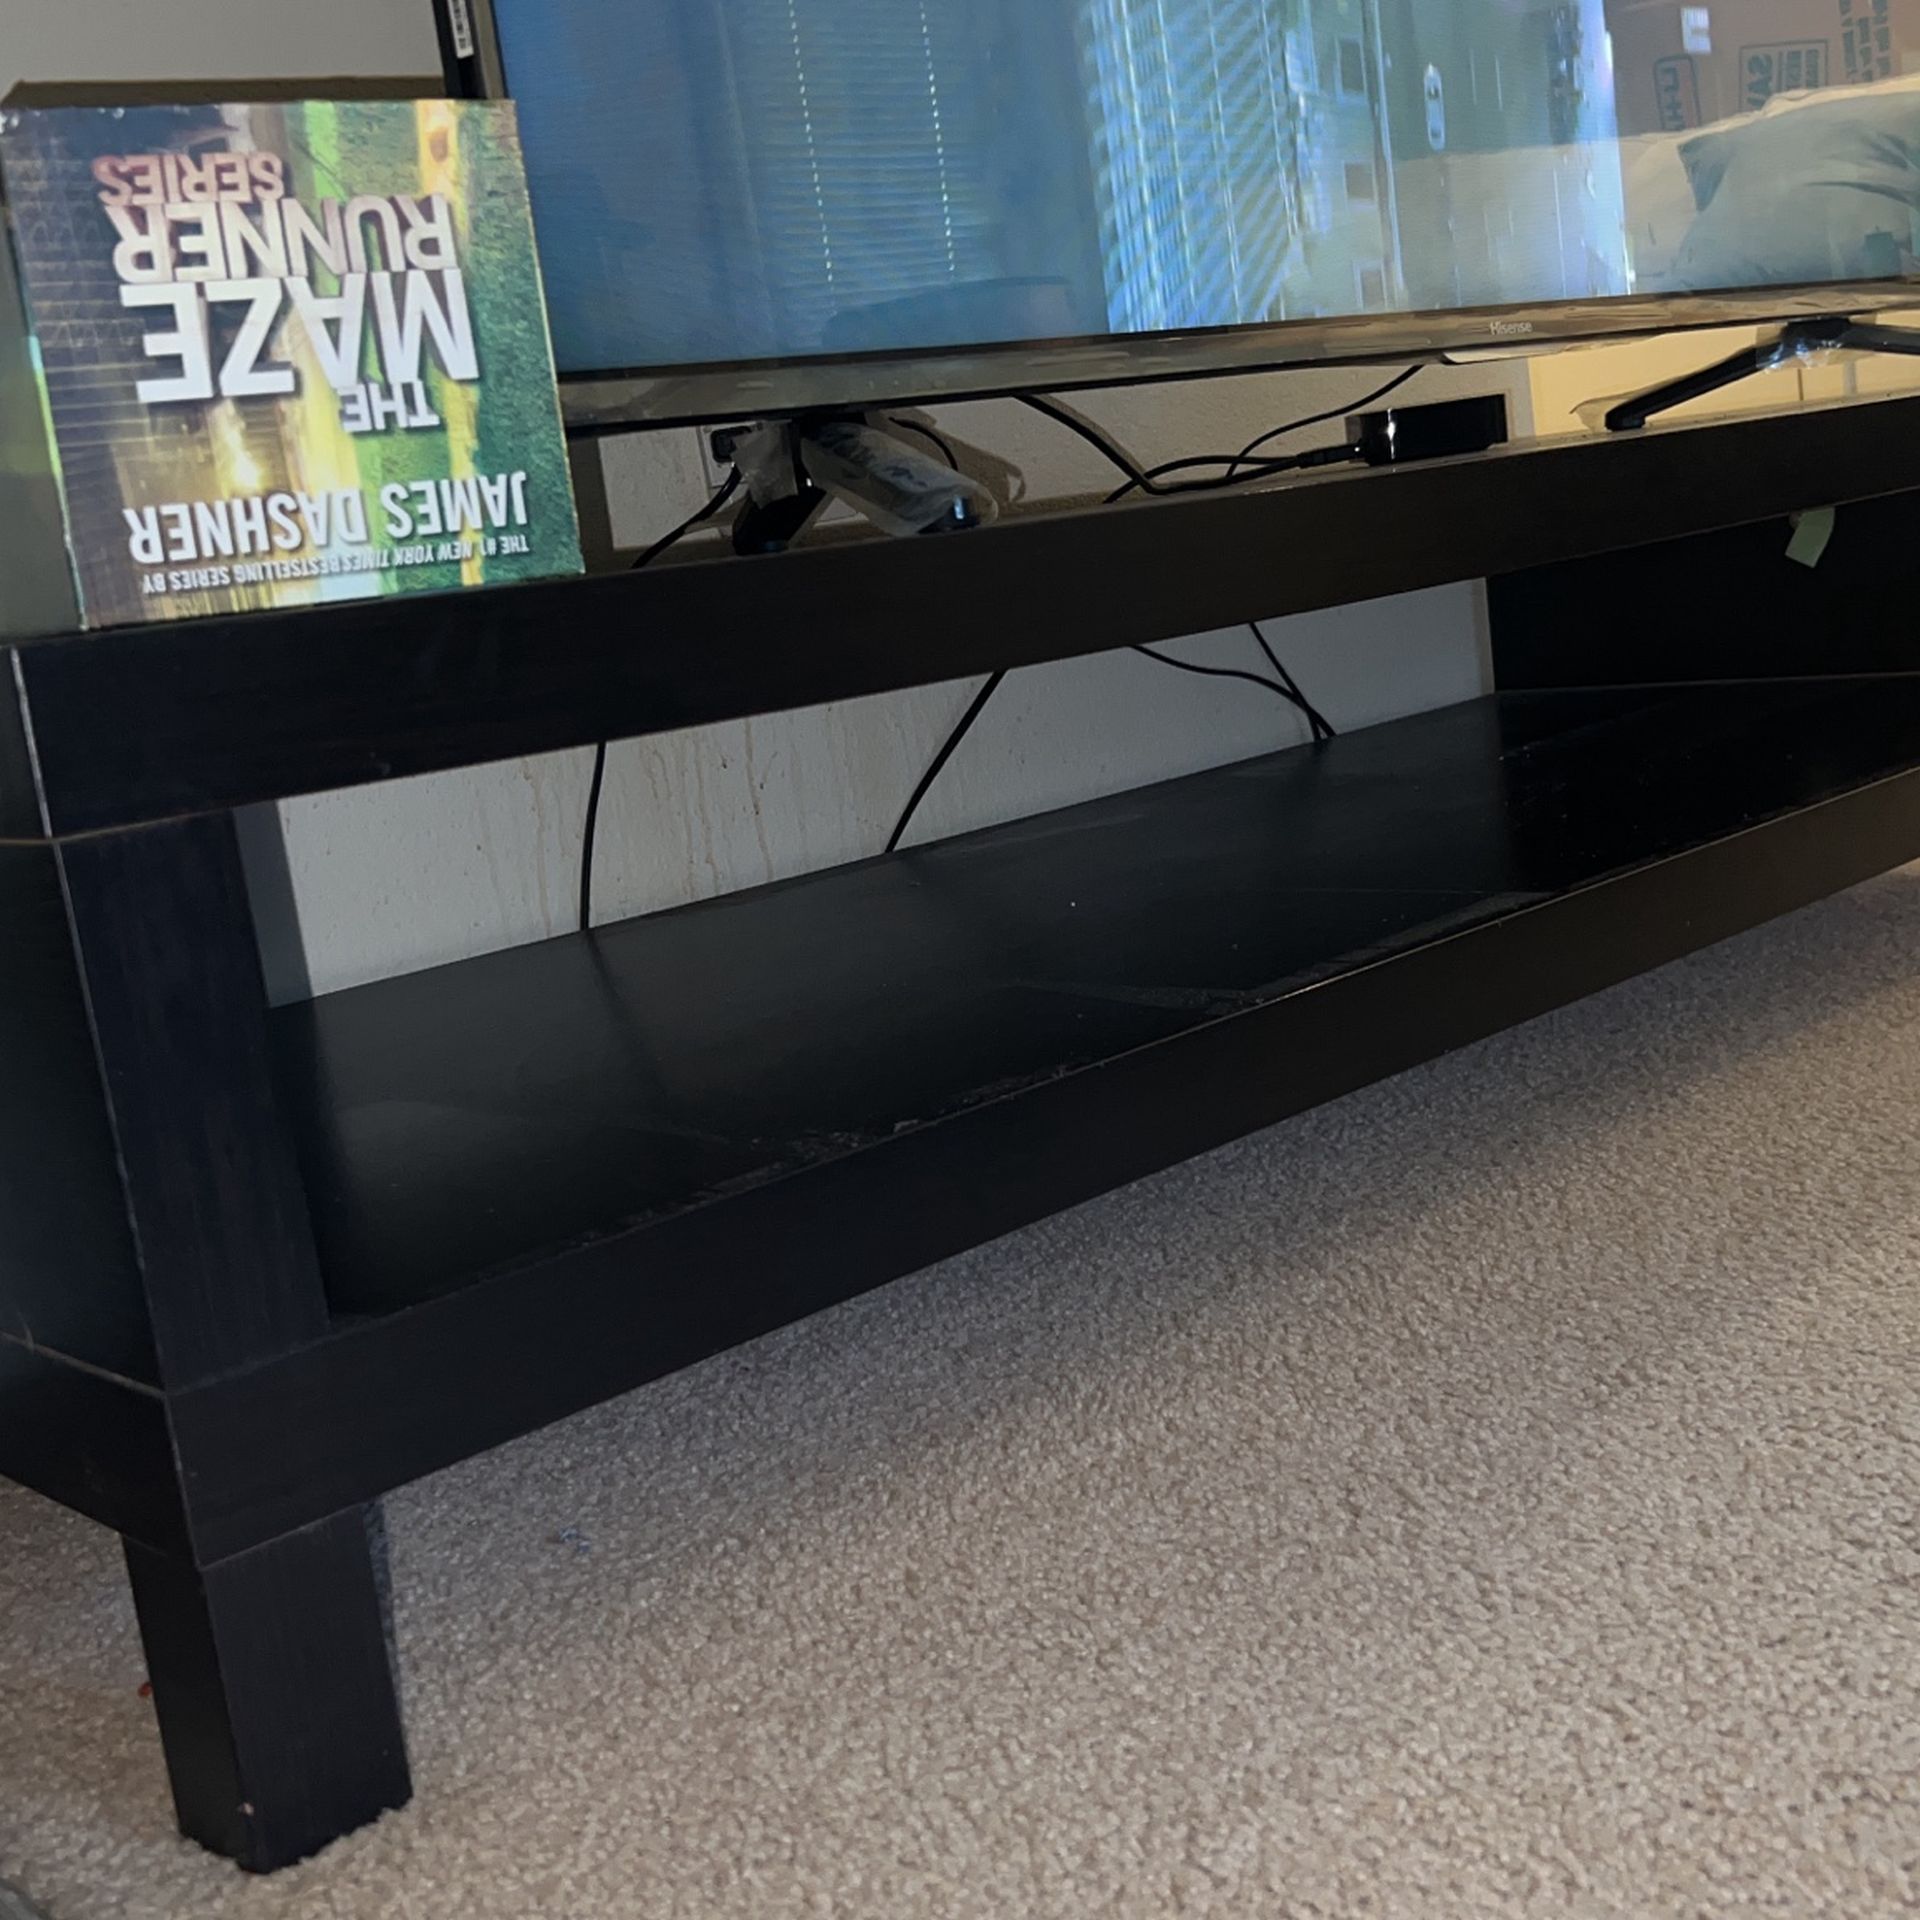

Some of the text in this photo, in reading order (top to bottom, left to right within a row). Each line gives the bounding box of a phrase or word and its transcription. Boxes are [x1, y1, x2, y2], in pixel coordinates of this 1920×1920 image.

[93, 152, 285, 205] SERIES
[106, 195, 460, 283] RUNNER
[119, 269, 480, 402] MAZE
[1489, 321, 1533, 335] Hisense
[341, 378, 441, 433] THE
[123, 471, 528, 564] JAMES DASHNER
[396, 545, 435, 567] YORK
[438, 541, 473, 561] NEW
[481, 537, 497, 556] #1
[501, 534, 530, 555] THE
[143, 572, 168, 594] BY
[169, 565, 231, 591] SERIES
